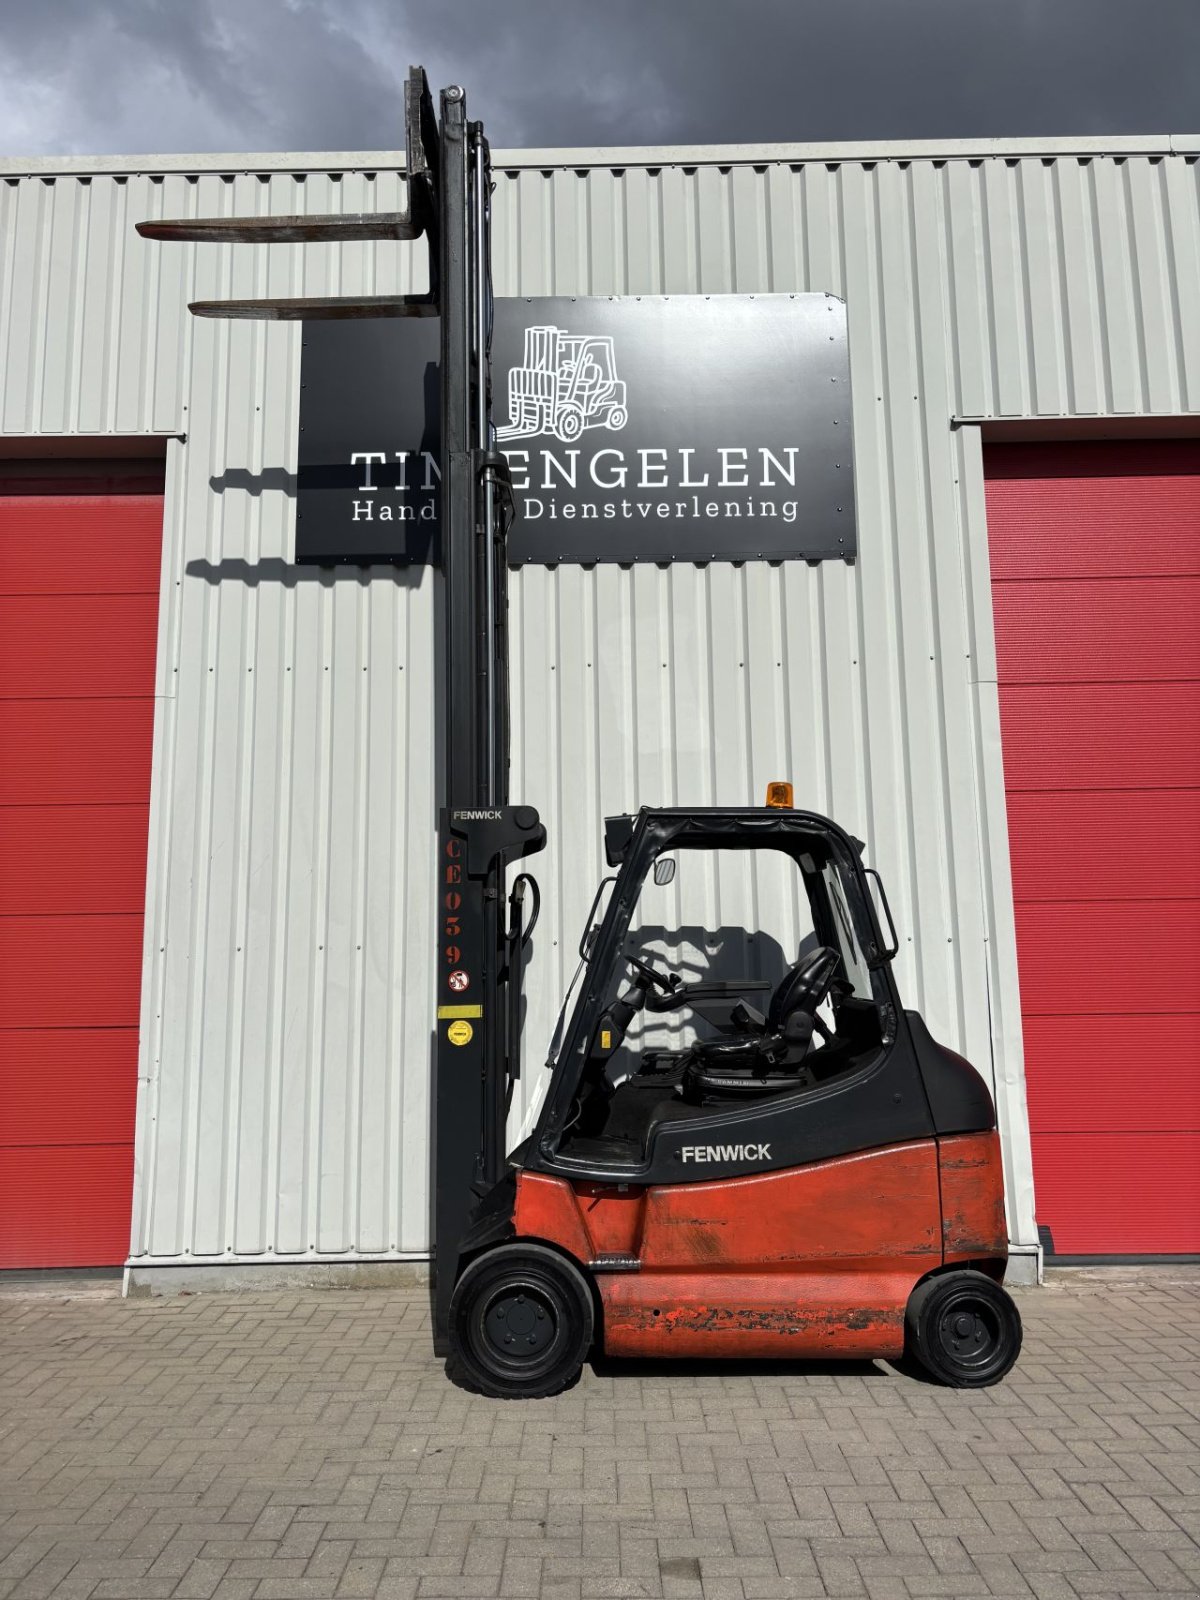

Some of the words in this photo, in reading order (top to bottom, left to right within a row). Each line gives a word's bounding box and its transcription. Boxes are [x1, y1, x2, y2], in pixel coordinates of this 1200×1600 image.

[499, 448, 800, 489] ENGELEN
[352, 499, 437, 521] Hand
[523, 496, 799, 523] Dienstverlening
[453, 810, 502, 820] FENWICK
[682, 1144, 772, 1163] FENWICK
